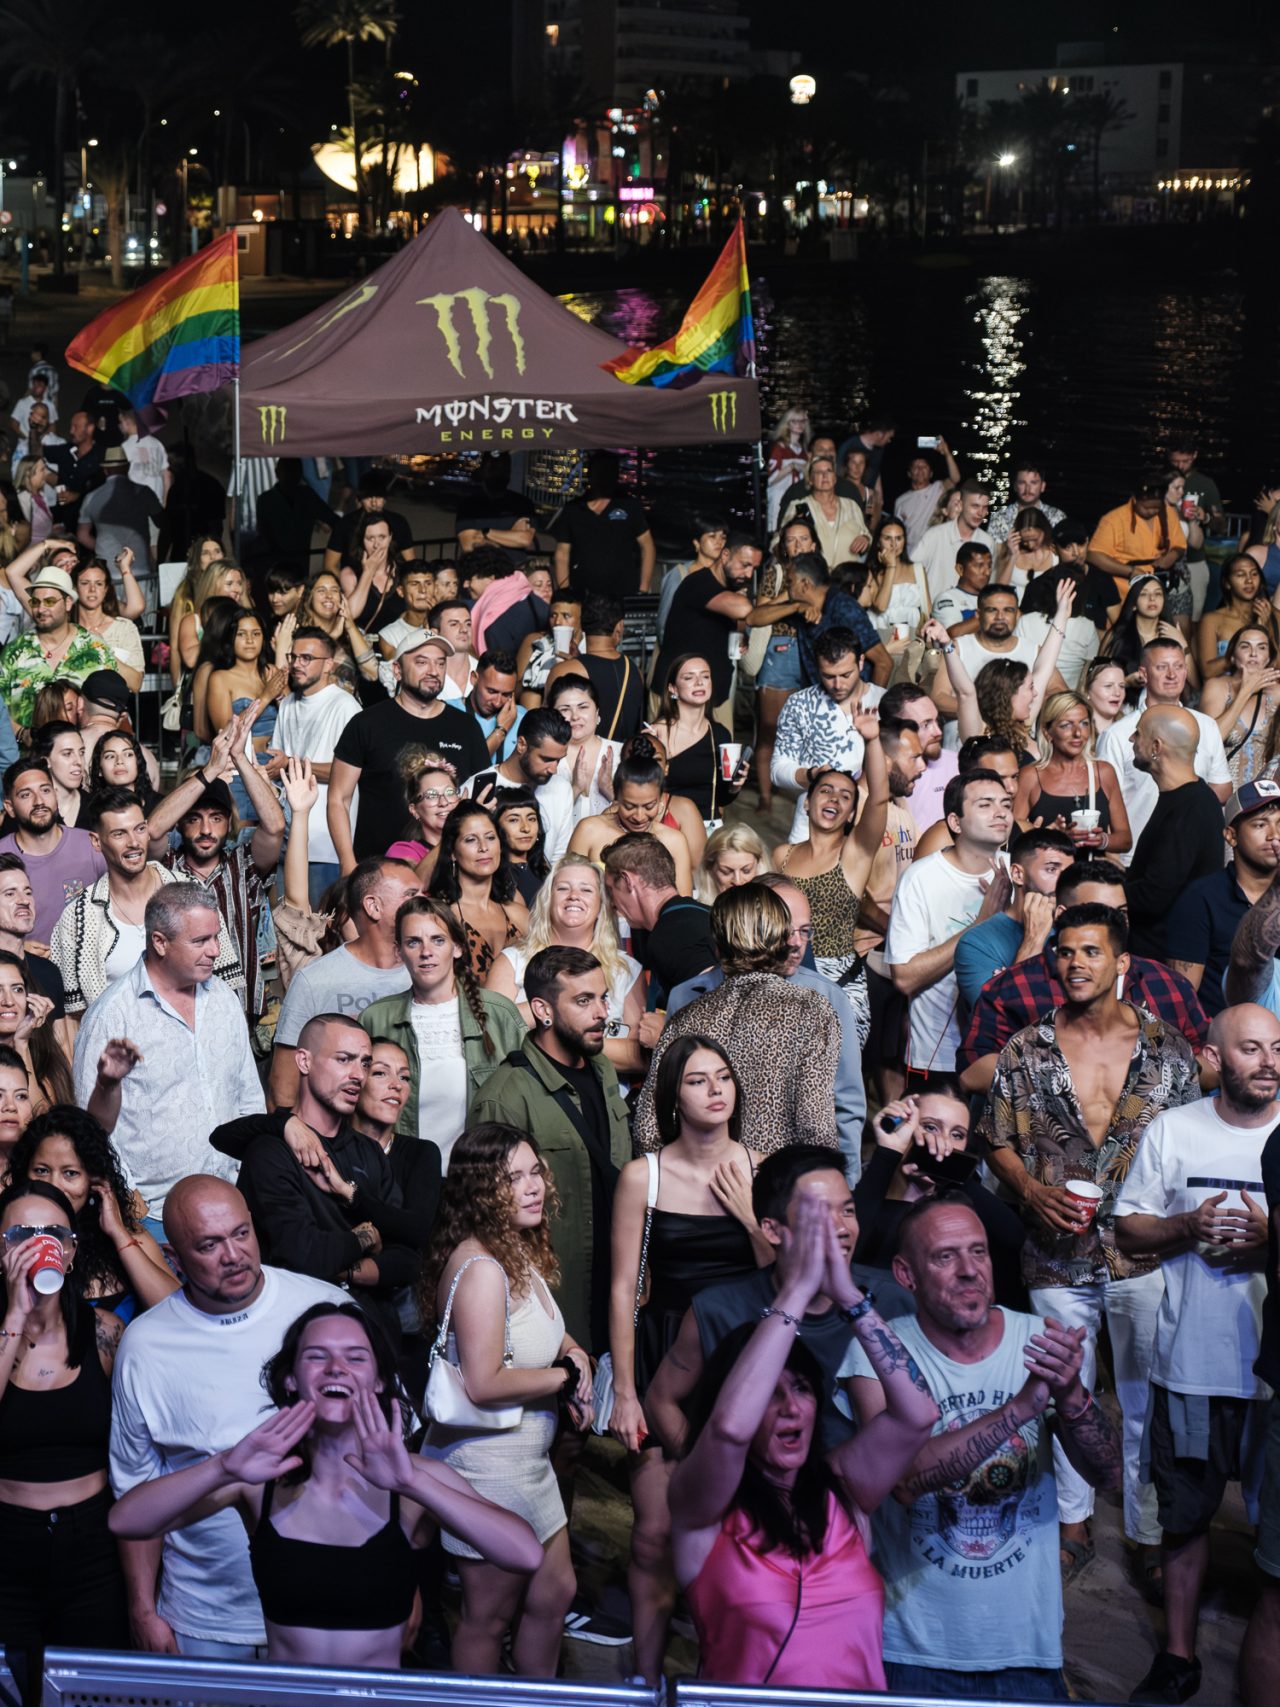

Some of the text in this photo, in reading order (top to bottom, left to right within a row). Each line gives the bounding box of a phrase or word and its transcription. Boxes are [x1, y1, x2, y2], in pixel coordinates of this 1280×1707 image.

[415, 395, 579, 427] MONSTER
[440, 428, 554, 443] ENERGY
[921, 1546, 1026, 1580] LA MUERTE
